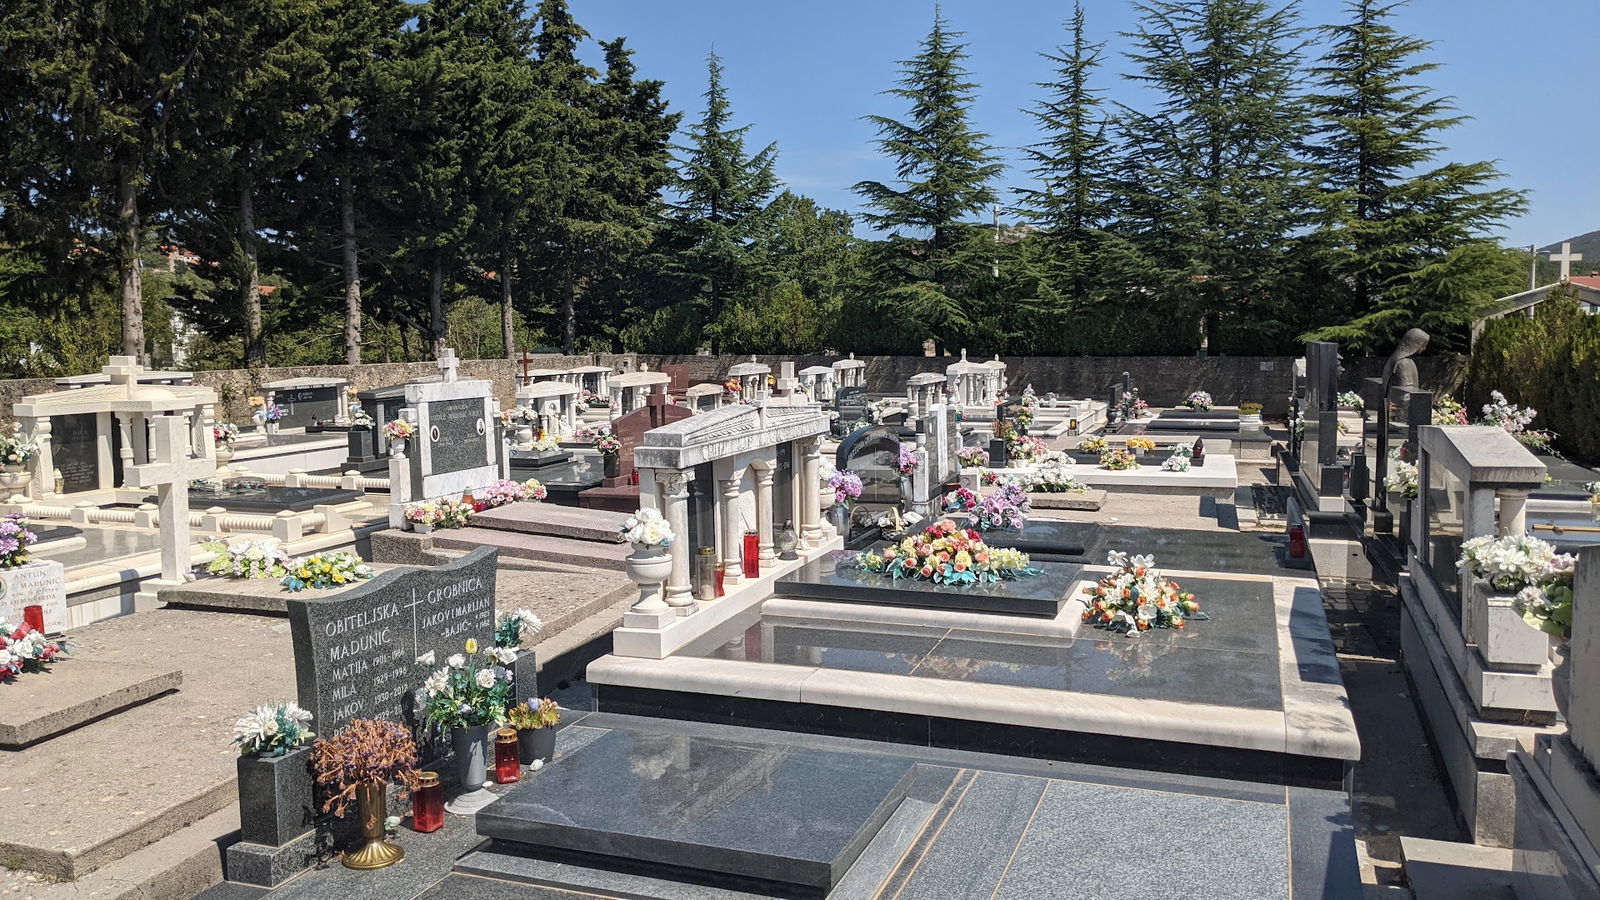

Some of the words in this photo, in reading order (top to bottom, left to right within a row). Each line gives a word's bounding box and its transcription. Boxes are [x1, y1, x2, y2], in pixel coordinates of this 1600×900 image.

[427, 578, 482, 604] GROBNICA
[325, 602, 399, 637] OBITELJSKA
[422, 609, 451, 629] JAKOV
[455, 596, 490, 617] MARIJAN
[329, 626, 391, 663] MADUNIĆ
[332, 683, 357, 702] MILA
[332, 698, 365, 724] JAKOV
